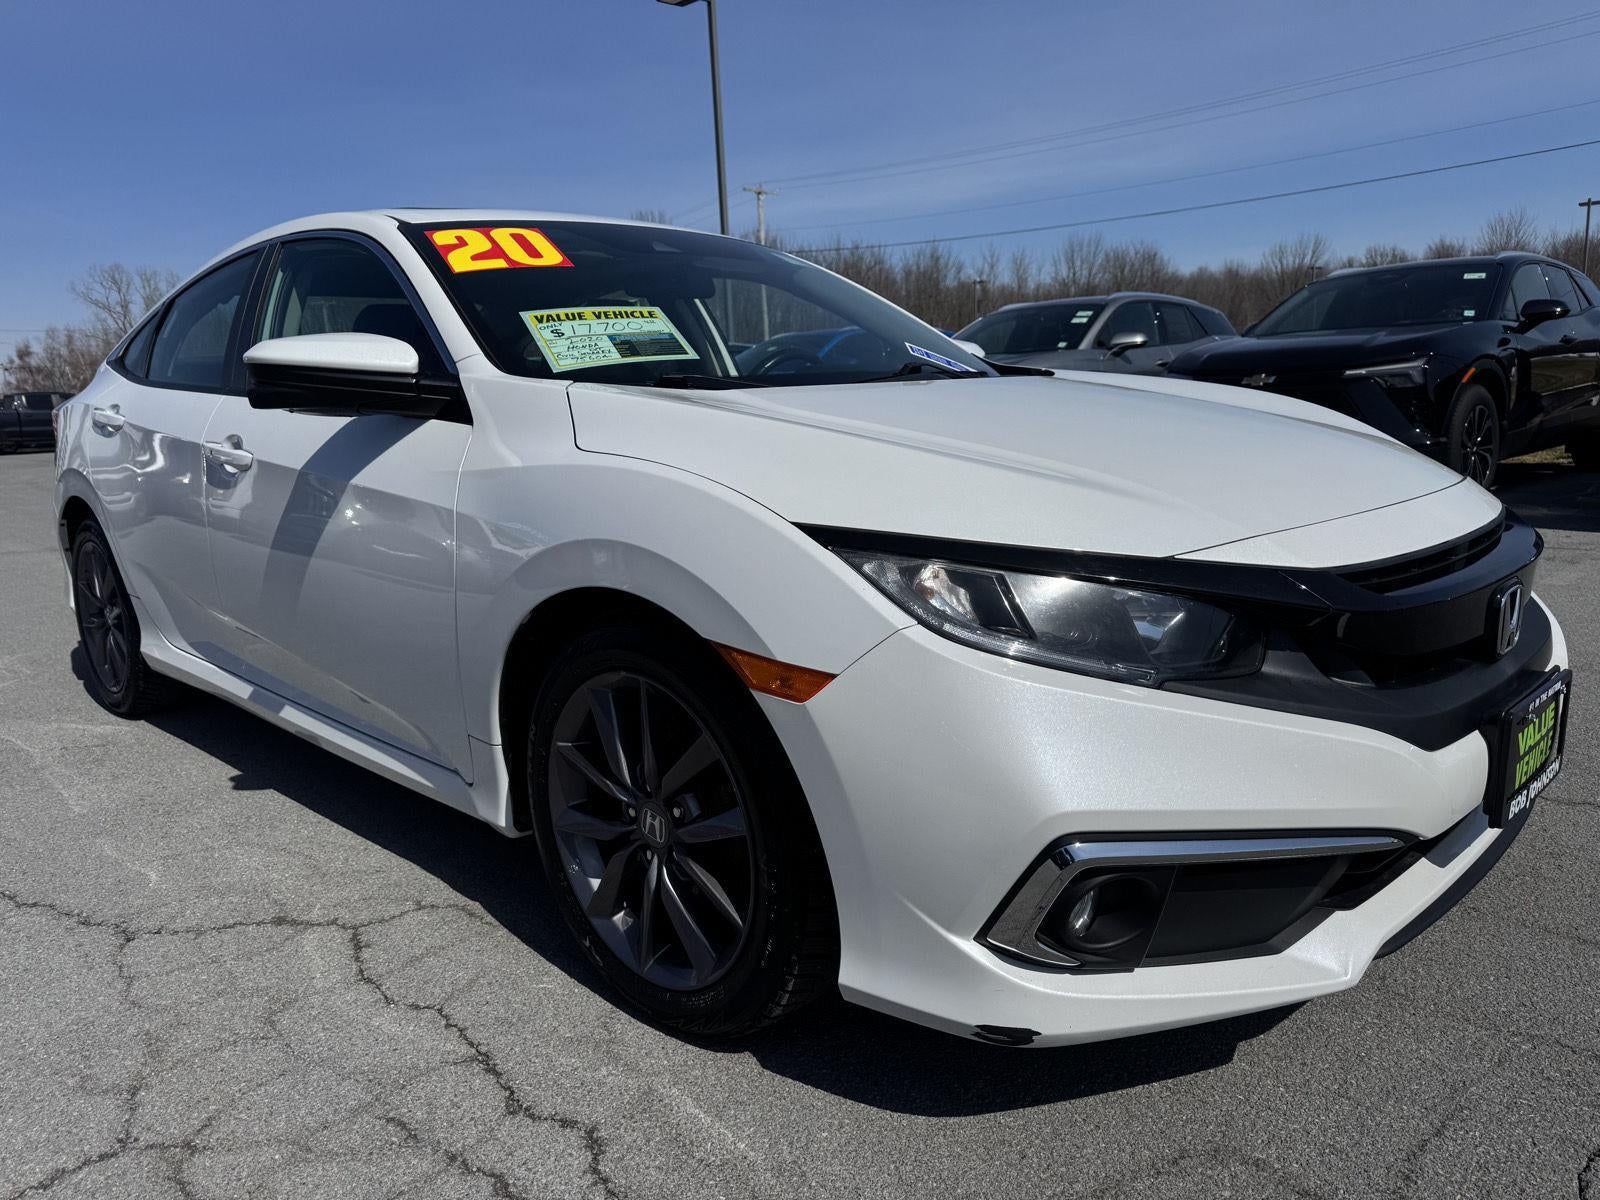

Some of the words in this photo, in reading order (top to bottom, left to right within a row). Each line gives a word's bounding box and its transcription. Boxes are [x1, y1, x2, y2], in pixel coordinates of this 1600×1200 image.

[432, 227, 563, 272] 20
[533, 312, 587, 324] VALUE
[592, 310, 658, 320] VEHICLE
[539, 323, 563, 331] ONLY
[1518, 701, 1556, 756] VALUE
[1514, 730, 1554, 791] VEHICLE
[1508, 790, 1528, 820] BOB
[1526, 756, 1561, 809] JOHNSON
